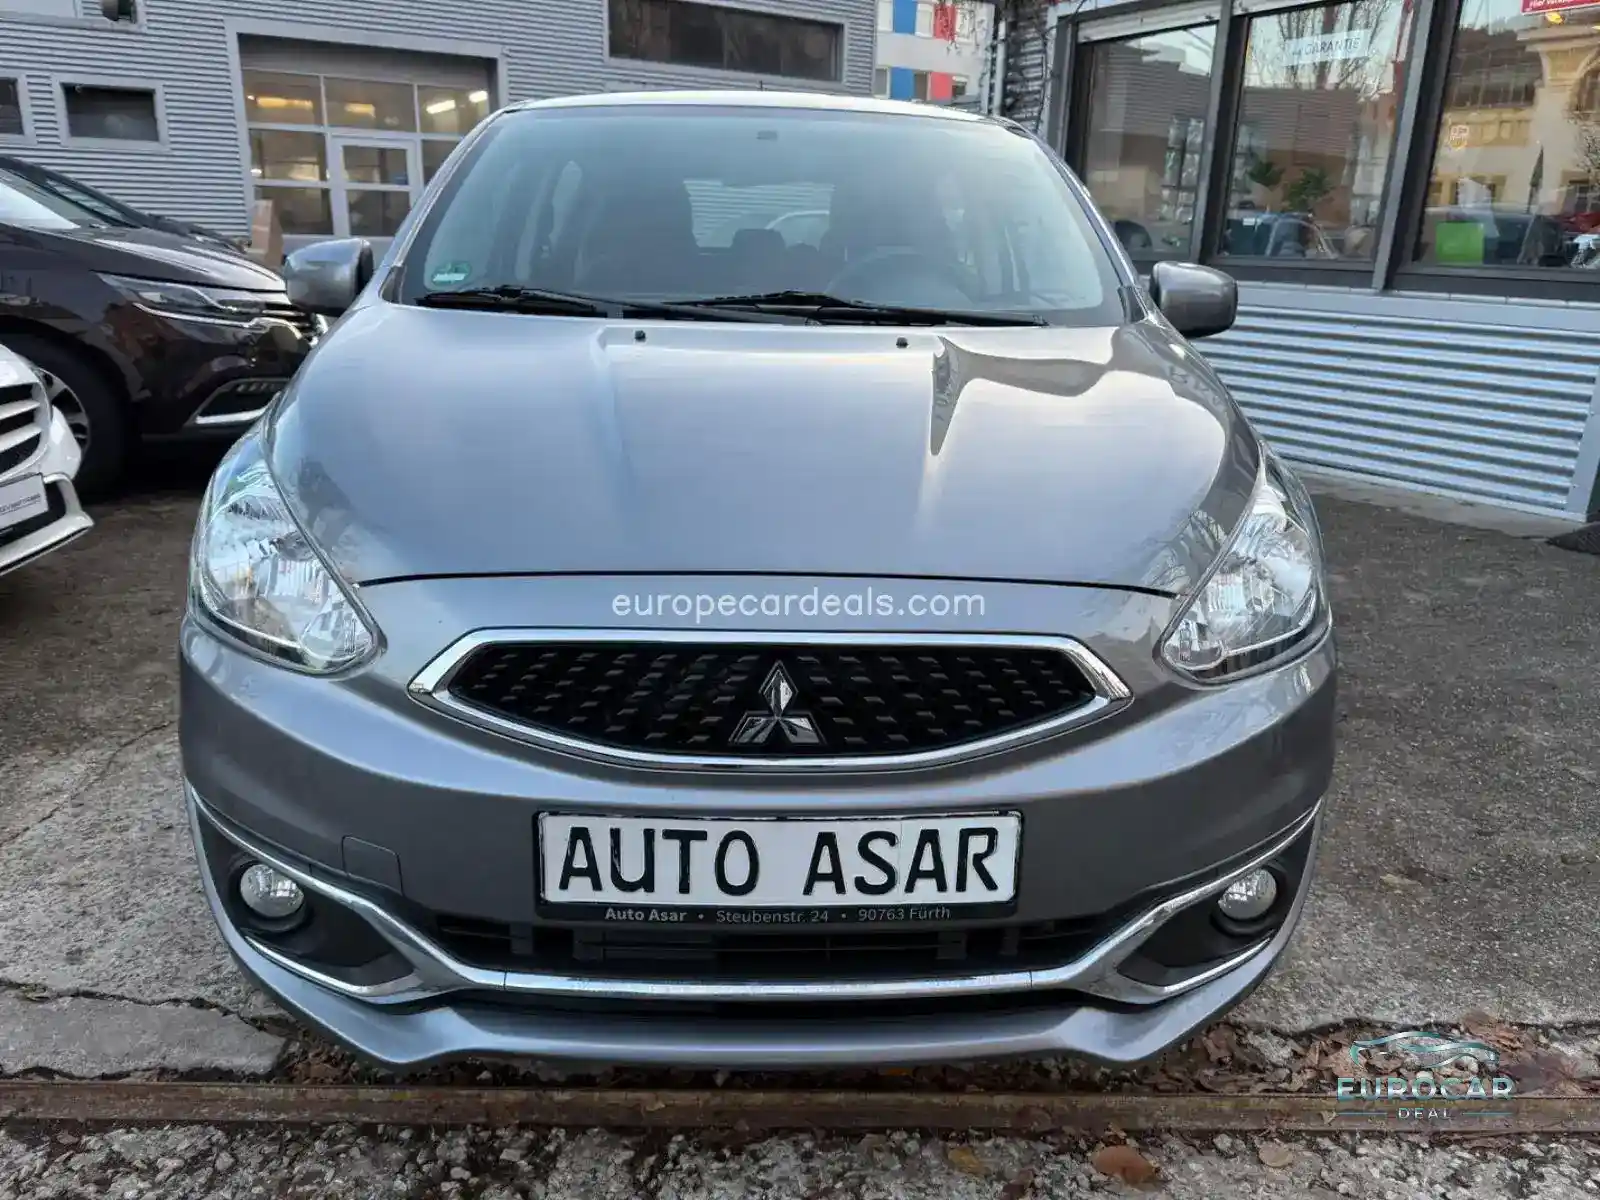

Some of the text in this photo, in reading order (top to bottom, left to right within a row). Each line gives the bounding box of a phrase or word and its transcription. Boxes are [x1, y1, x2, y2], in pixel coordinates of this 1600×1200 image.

[558, 826, 999, 896] AUTO ASAR
[604, 906, 951, 923] Auto Asar Steubenstr. 24 90763 Fürth
